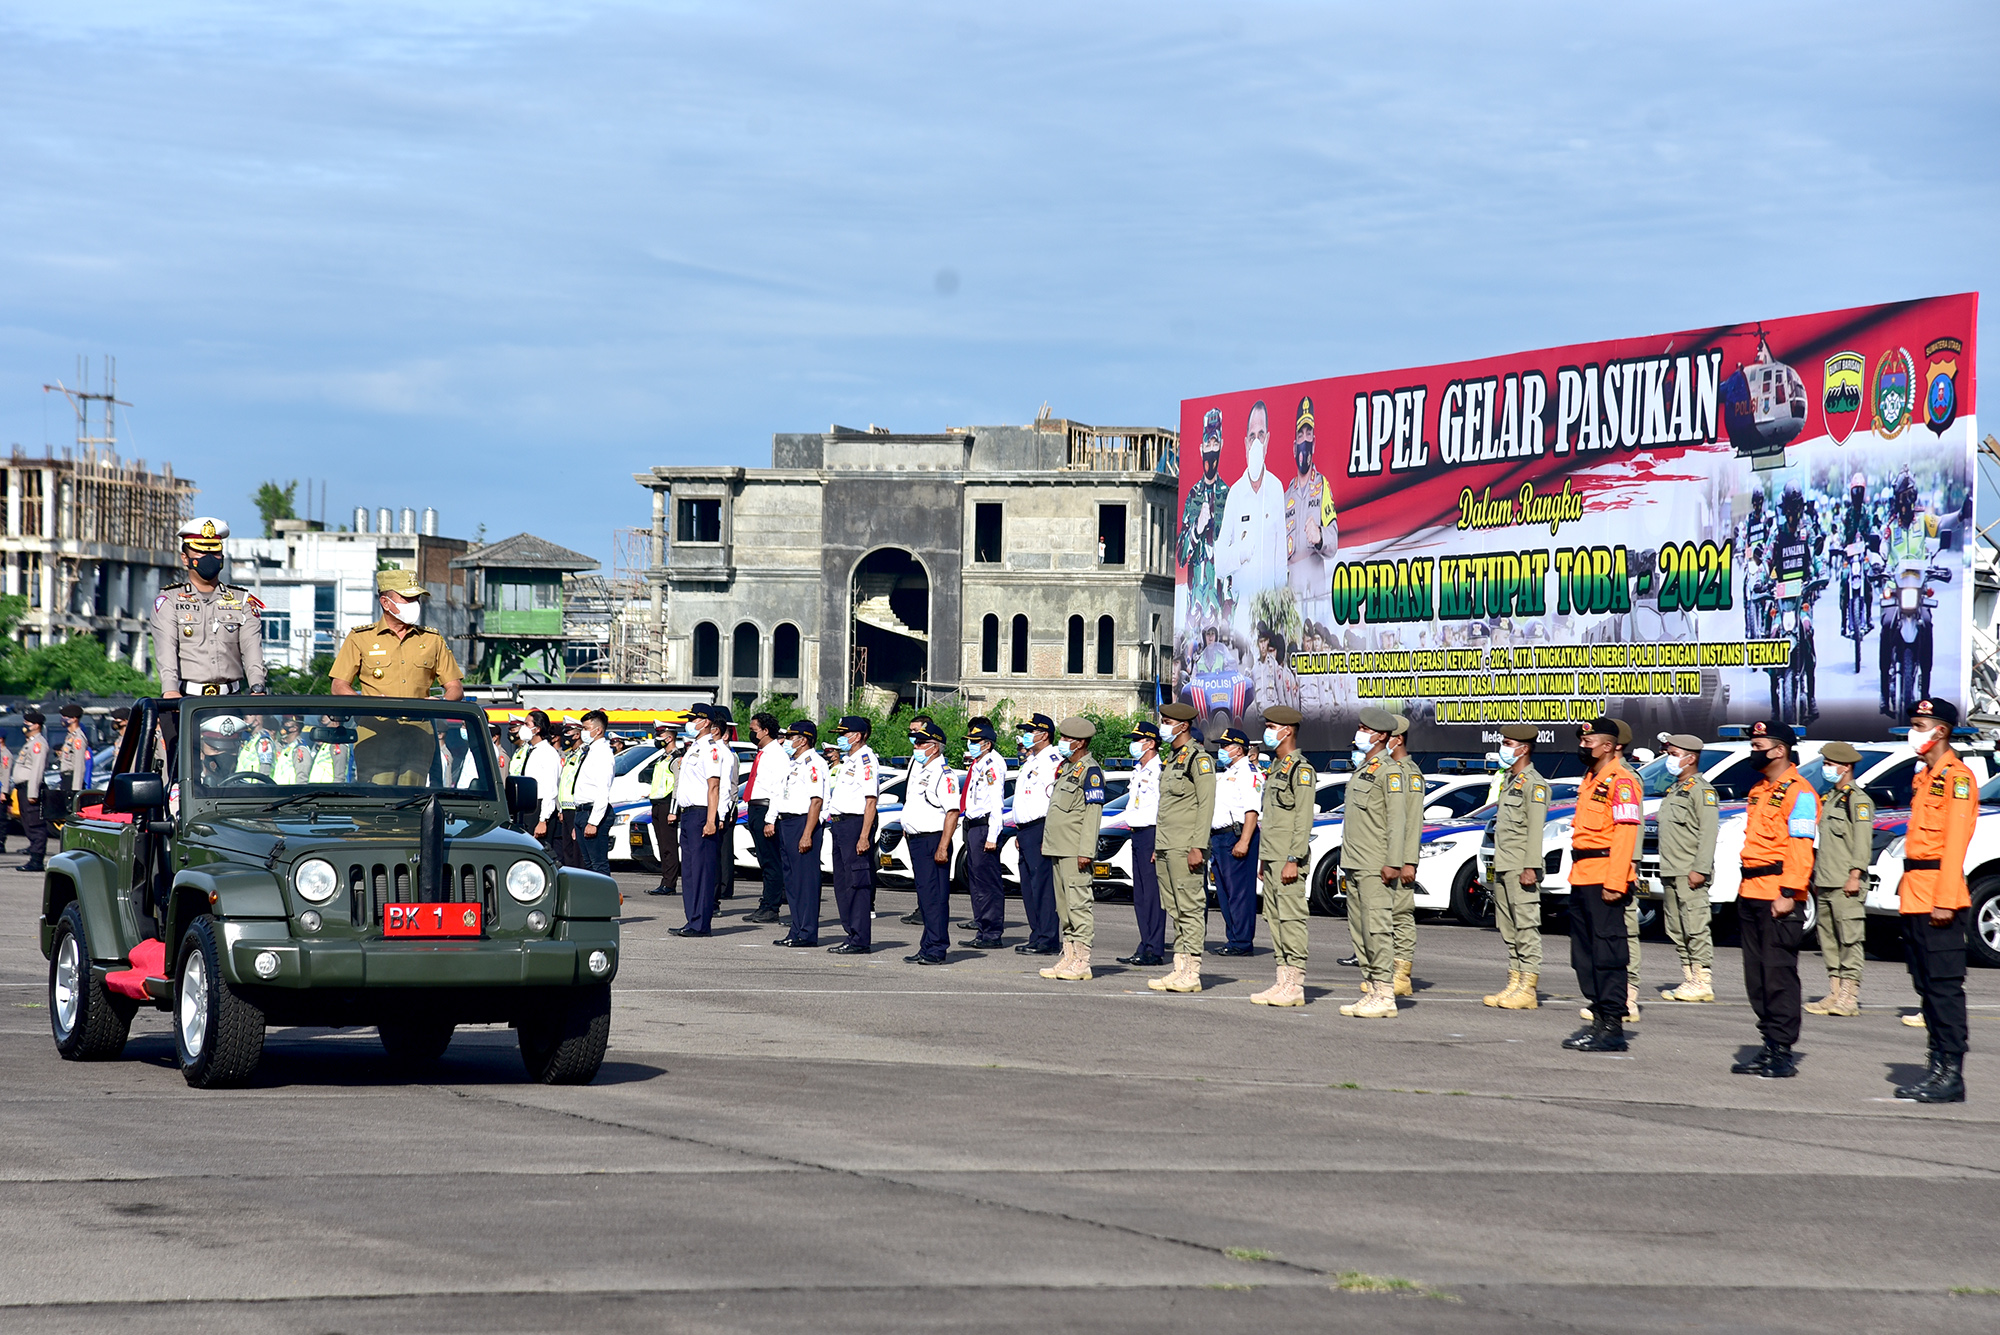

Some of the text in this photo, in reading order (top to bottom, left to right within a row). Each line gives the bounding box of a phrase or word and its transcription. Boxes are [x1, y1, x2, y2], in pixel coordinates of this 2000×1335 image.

[1842, 359, 1861, 374] BARISAN
[1348, 350, 1722, 475] APEL GELAR PASUKAN
[1457, 478, 1583, 534] Dalam Rangka
[1332, 560, 1434, 622] OPERASI
[1439, 551, 1548, 616] KETUPAT
[1555, 547, 1629, 610] TOBA
[1659, 541, 1731, 607] 2021
[175, 603, 200, 612] EKO TJ
[1296, 654, 1328, 674] MELALUI
[1329, 653, 1348, 673] APEL
[1349, 652, 1374, 673] GELAR
[1374, 651, 1410, 673] PASUKAN
[1411, 650, 1445, 672] OPERASI
[1446, 649, 1483, 671] KETUPAT
[1490, 648, 1512, 671] 2021,
[1513, 647, 1533, 669] KITA
[1534, 646, 1590, 668] TINGKATKAN
[1591, 645, 1627, 668] SINERGI
[1629, 645, 1657, 667] POLRI
[1658, 644, 1698, 666] DENGAN
[1699, 642, 1745, 665] INSTANSI
[1746, 641, 1790, 663] TERKAIT
[1191, 673, 1245, 691] BM POLISI BM
[1357, 672, 1700, 698] DALAM RANGKA MEMBERIKAN RASA AMAN DAN NYAMAN PADA PERAYAAN IDUL FITRI
[1436, 701, 1445, 722] DI
[1446, 701, 1481, 722] WILAYAH
[1482, 700, 1520, 722] PROVINSI
[1521, 700, 1568, 722] SUMATERA
[1569, 700, 1599, 722] UTARA
[1481, 730, 1556, 744] Meda 2021
[389, 907, 443, 930] BK 1
